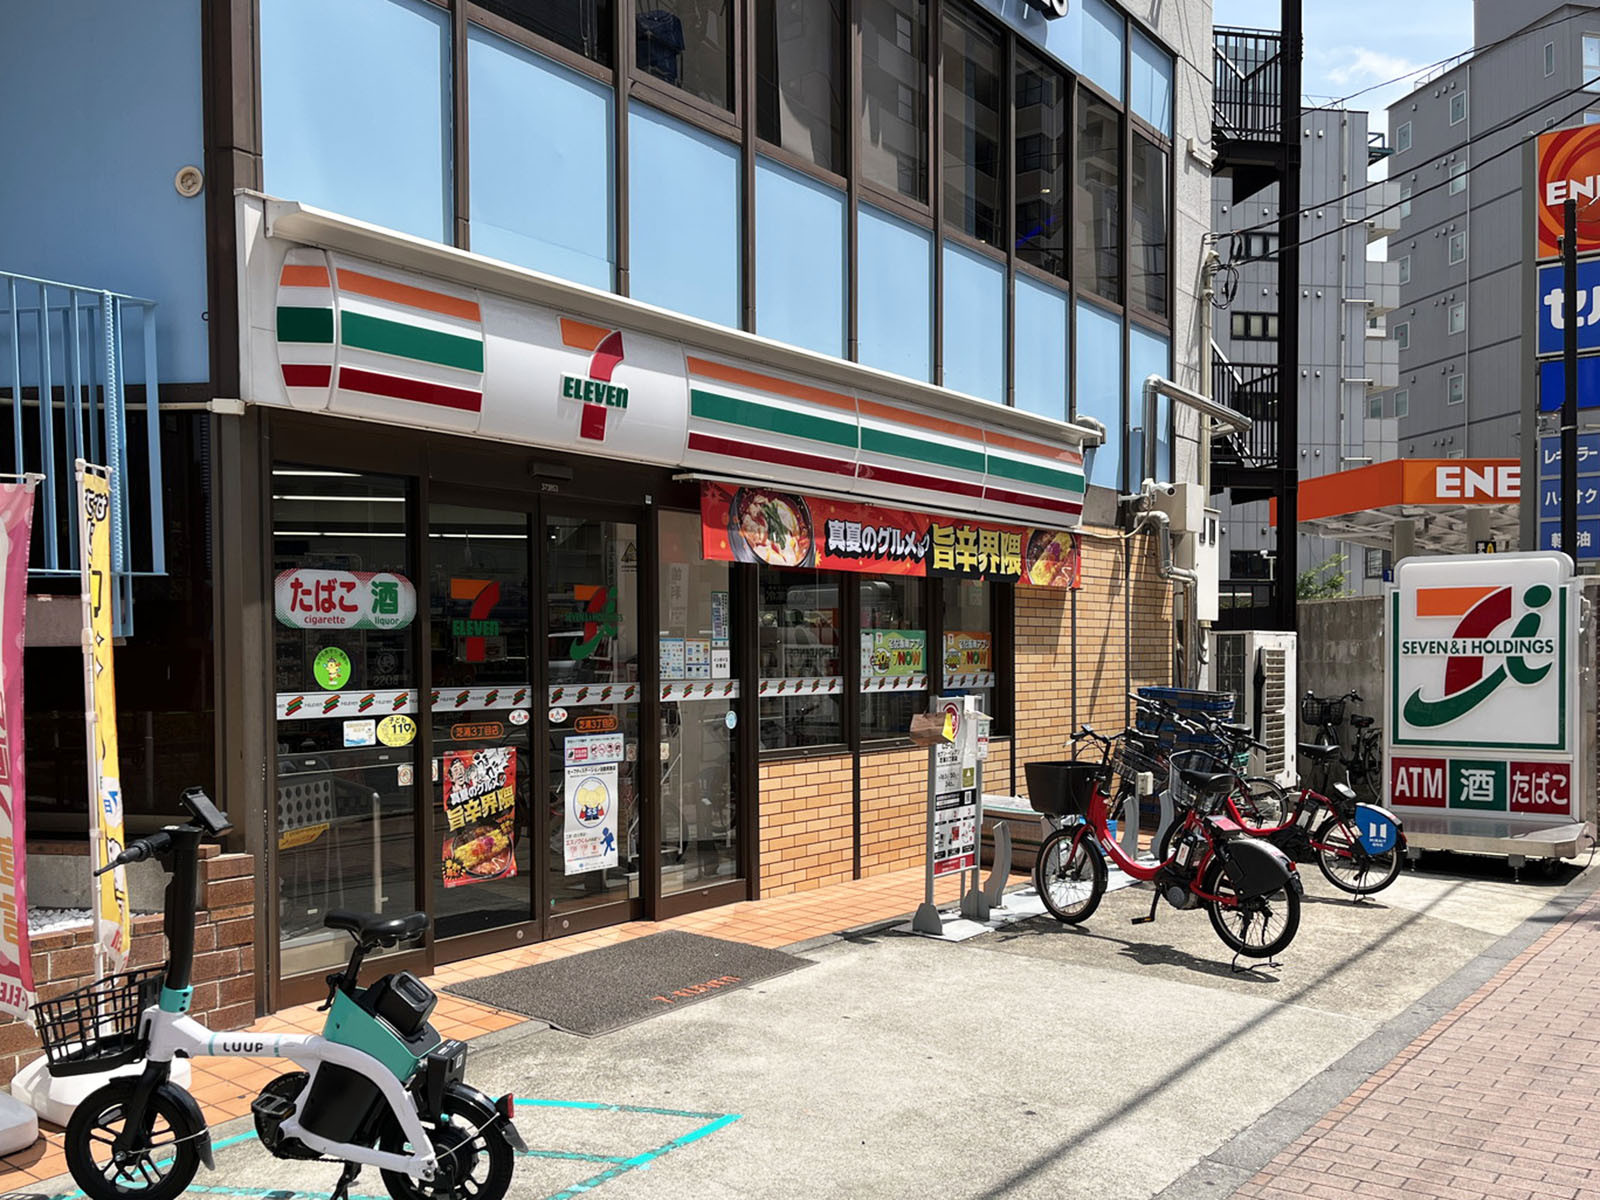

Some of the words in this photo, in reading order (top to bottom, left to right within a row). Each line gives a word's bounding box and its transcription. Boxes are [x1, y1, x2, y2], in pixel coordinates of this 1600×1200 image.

[1546, 173, 1600, 206] EN
[932, 523, 1022, 575] 旨辛界隈
[290, 577, 358, 613] たばこ
[371, 581, 399, 614] 酒
[304, 615, 346, 626] cigarette
[374, 615, 400, 626] liquor
[1472, 639, 1554, 654] HOLDINGS
[1395, 767, 1443, 799] ATM
[1460, 769, 1496, 801] 酒
[1512, 771, 1568, 805] たばこ
[223, 1041, 263, 1053] LUUP
